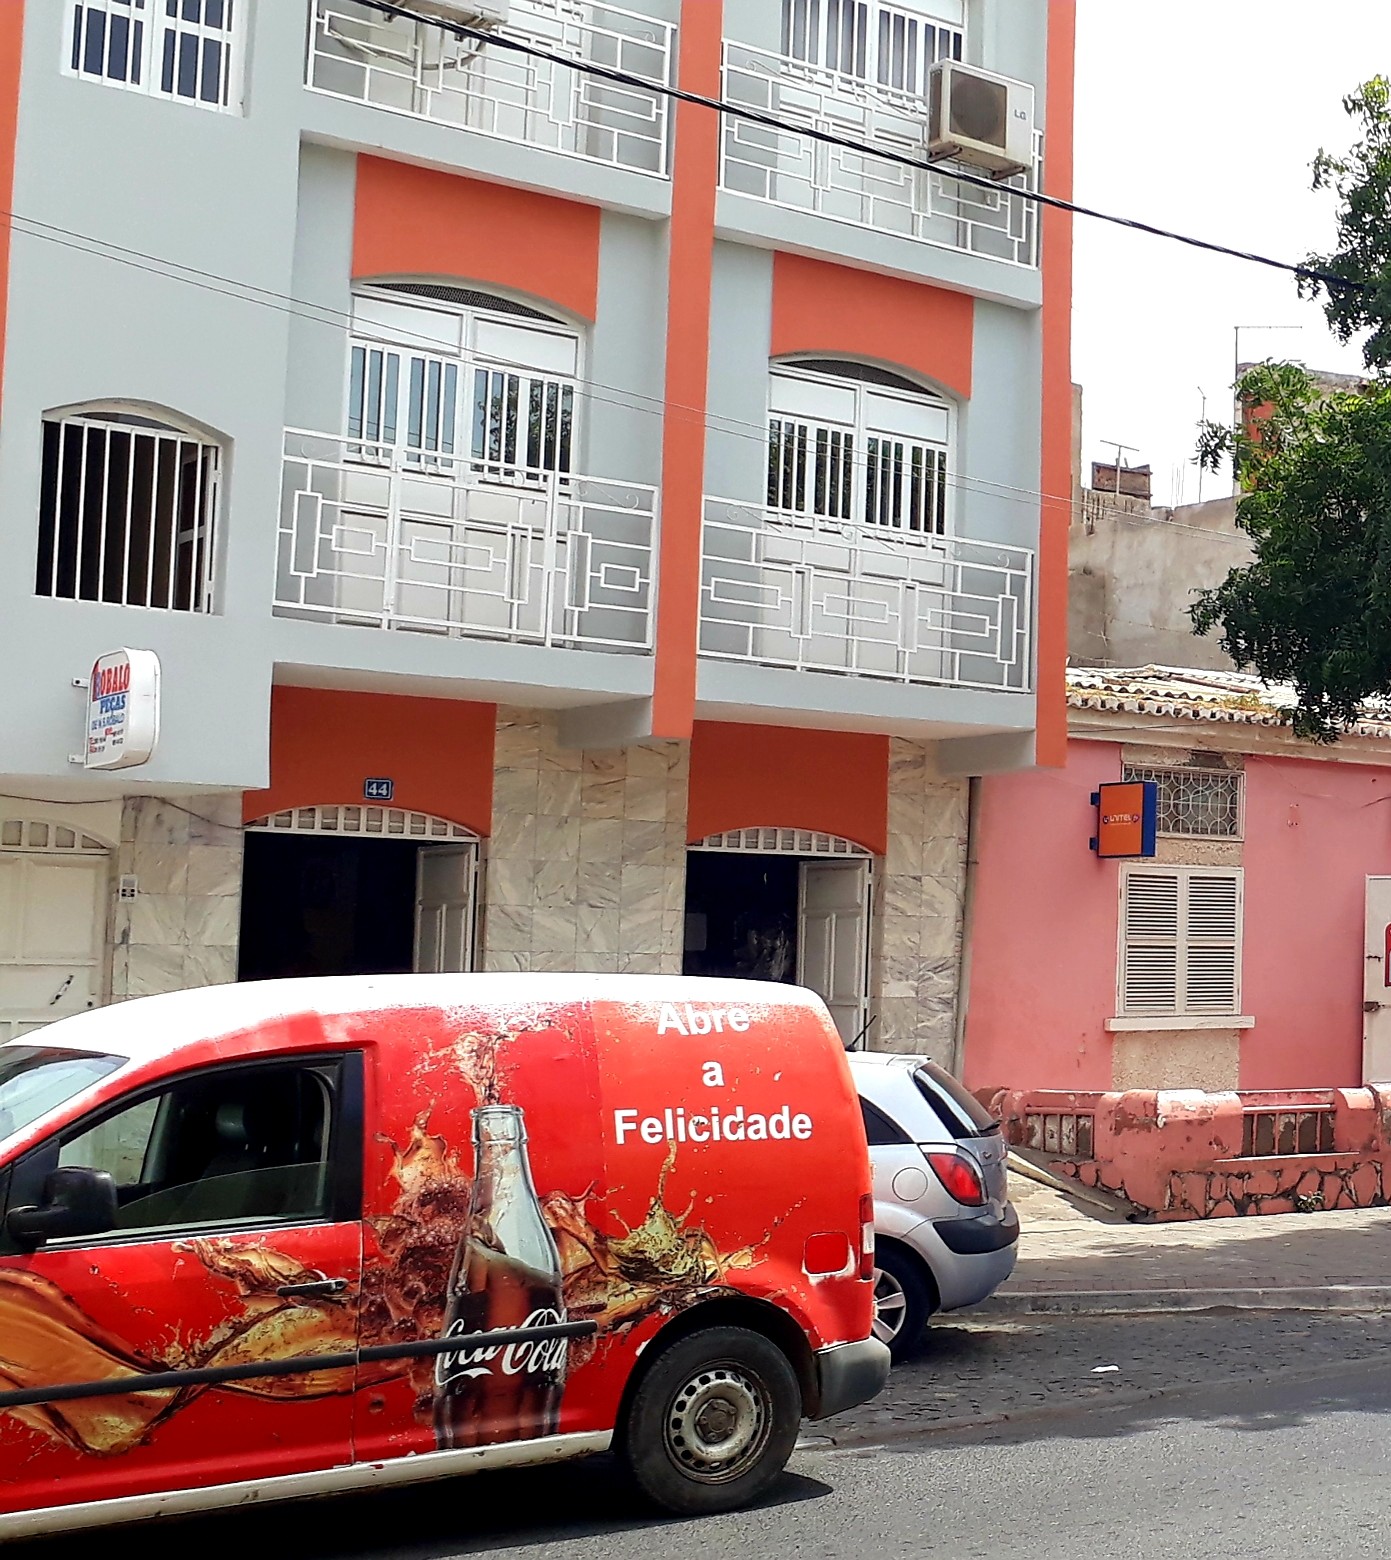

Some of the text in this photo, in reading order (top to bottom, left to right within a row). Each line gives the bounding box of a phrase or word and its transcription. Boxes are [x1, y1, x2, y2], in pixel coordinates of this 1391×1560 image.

[92, 661, 131, 702] ROBALO
[368, 782, 388, 796] 44
[656, 1002, 751, 1036] Abre
[701, 1060, 725, 1087] a
[613, 1104, 813, 1145] Felicidade
